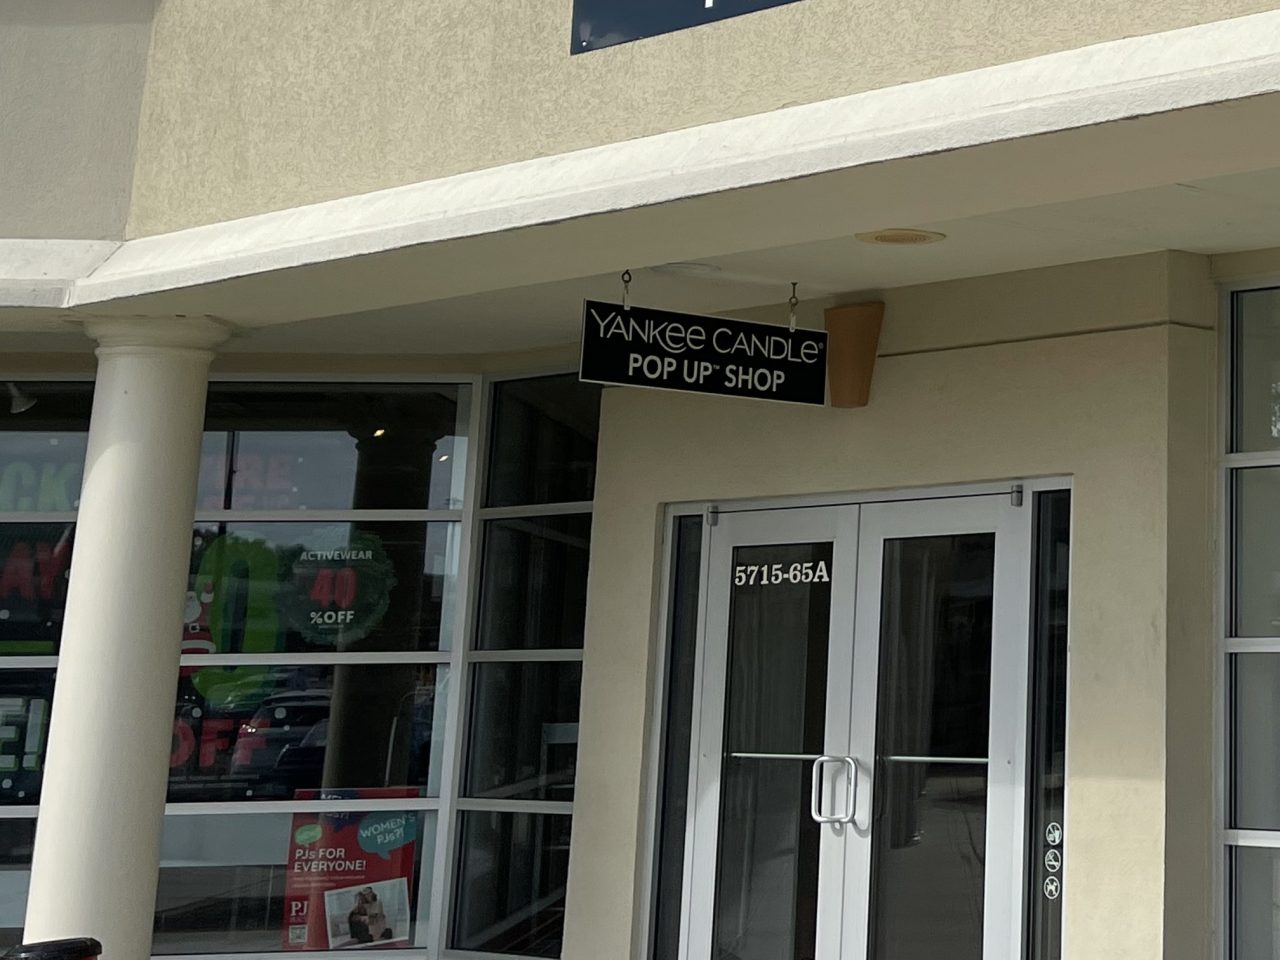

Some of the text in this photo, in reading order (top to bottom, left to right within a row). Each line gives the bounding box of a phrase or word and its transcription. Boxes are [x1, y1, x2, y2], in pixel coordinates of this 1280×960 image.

[628, 353, 677, 380] POP
[724, 364, 785, 392] SHOP
[300, 550, 373, 561] ACTIVEWEAR
[734, 560, 830, 586] 5715-65A
[310, 566, 356, 608] 40
[309, 610, 355, 625] %OFF
[318, 847, 345, 859] FOR
[293, 860, 367, 873] EVERYONE!
[290, 900, 308, 917] PJ
